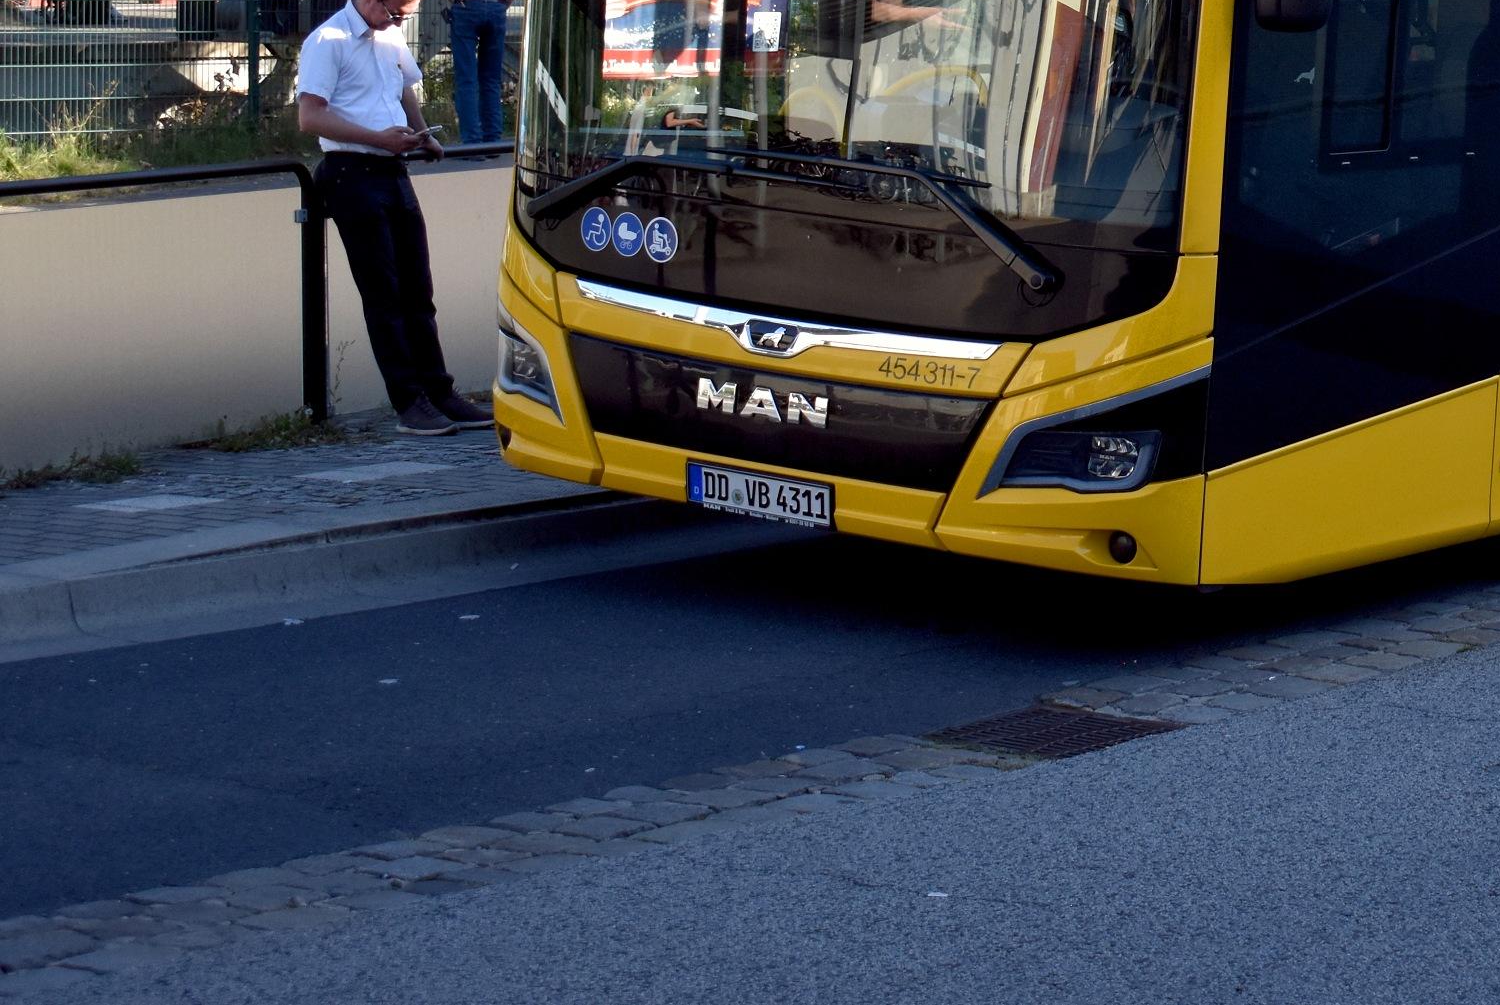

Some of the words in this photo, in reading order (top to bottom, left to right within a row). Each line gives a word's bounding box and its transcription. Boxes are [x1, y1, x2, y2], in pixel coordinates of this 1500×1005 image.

[697, 378, 829, 429] MAN
[703, 471, 729, 501] DD
[745, 478, 770, 509] VB
[776, 485, 827, 519] 4311
